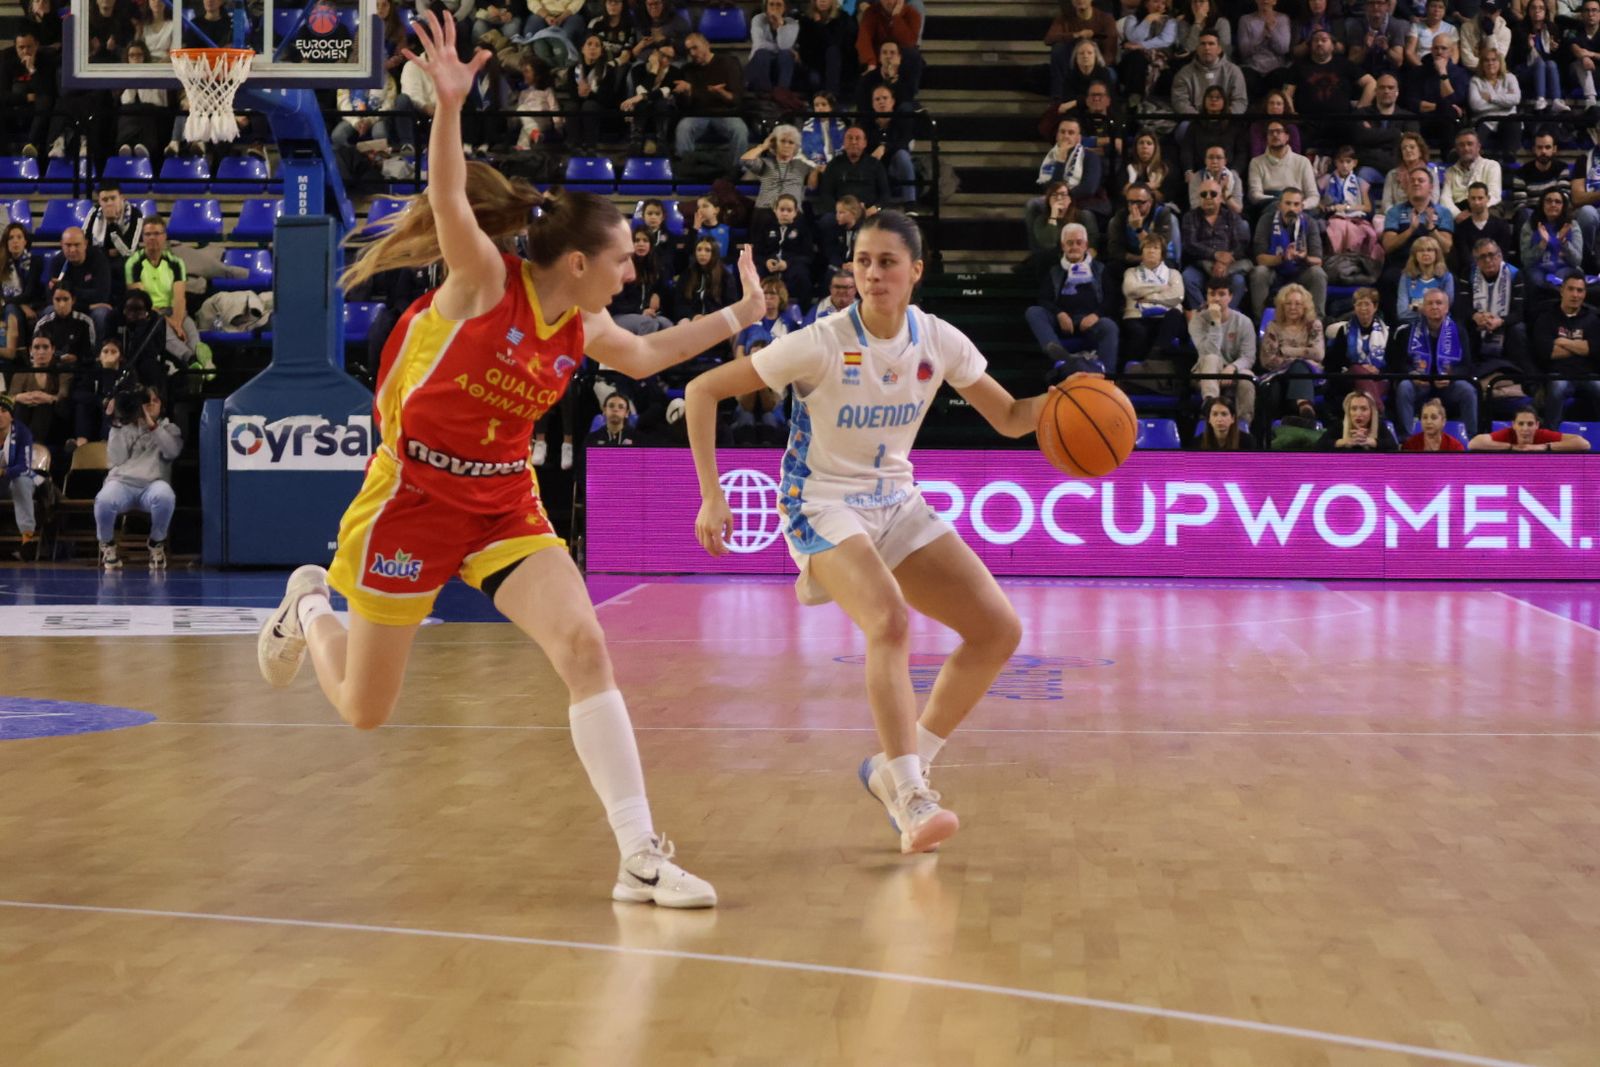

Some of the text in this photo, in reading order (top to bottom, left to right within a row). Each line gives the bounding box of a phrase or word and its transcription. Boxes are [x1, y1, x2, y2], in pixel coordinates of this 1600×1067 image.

[295, 39, 352, 49] EUROCUP
[300, 49, 348, 59] WOMEN
[297, 175, 309, 216] MONDO
[485, 368, 558, 405] QUALCO
[480, 418, 501, 445] 1
[915, 480, 1593, 549] ROCUPWOMEN.
